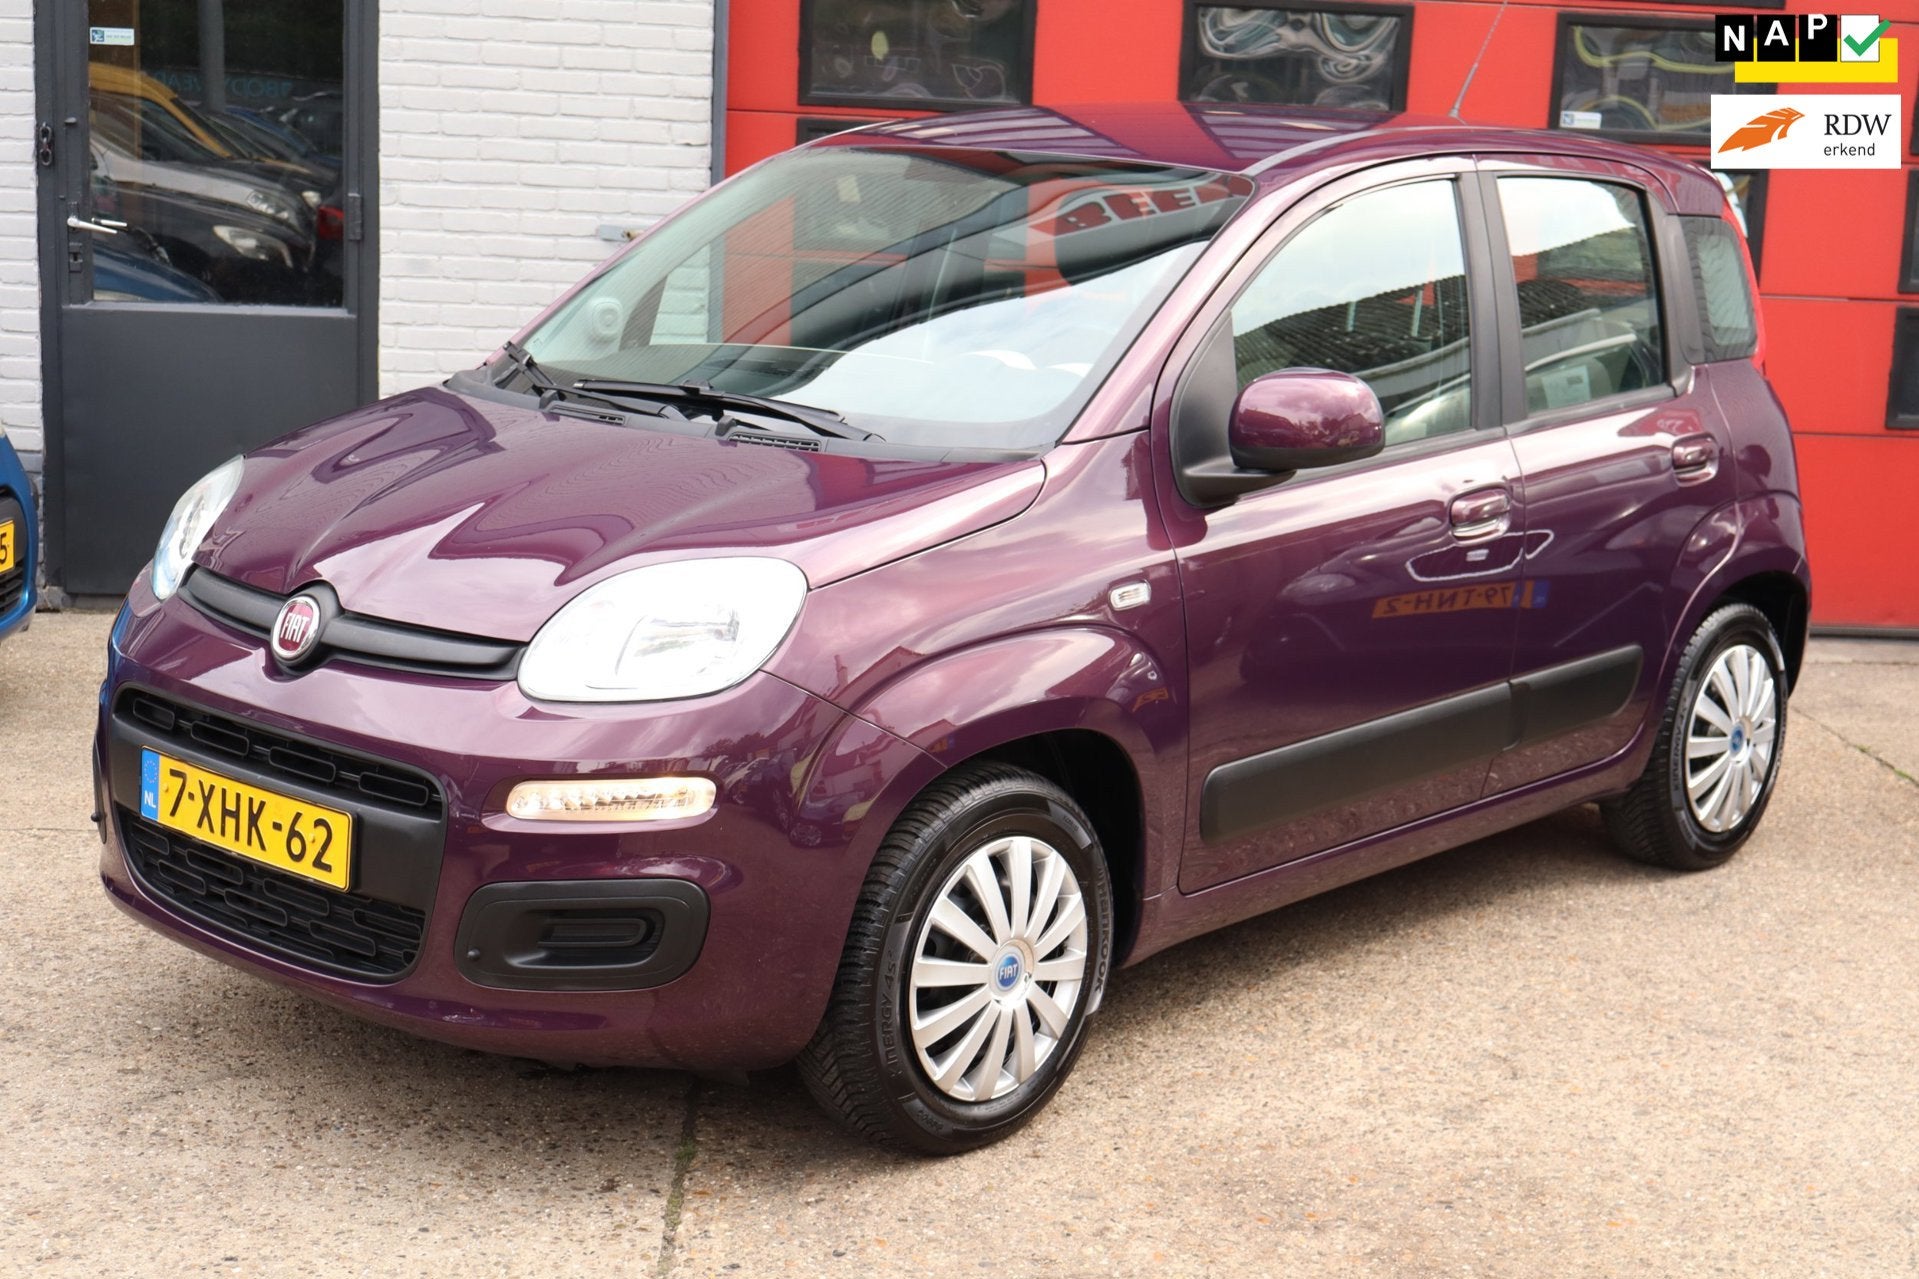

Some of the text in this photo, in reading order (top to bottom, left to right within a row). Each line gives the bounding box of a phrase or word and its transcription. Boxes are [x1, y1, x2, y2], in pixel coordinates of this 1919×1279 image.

[280, 612, 311, 644] FIAT
[144, 790, 158, 809] NL
[169, 767, 333, 873] 7-XHK-62
[999, 963, 1018, 980] FIAT
